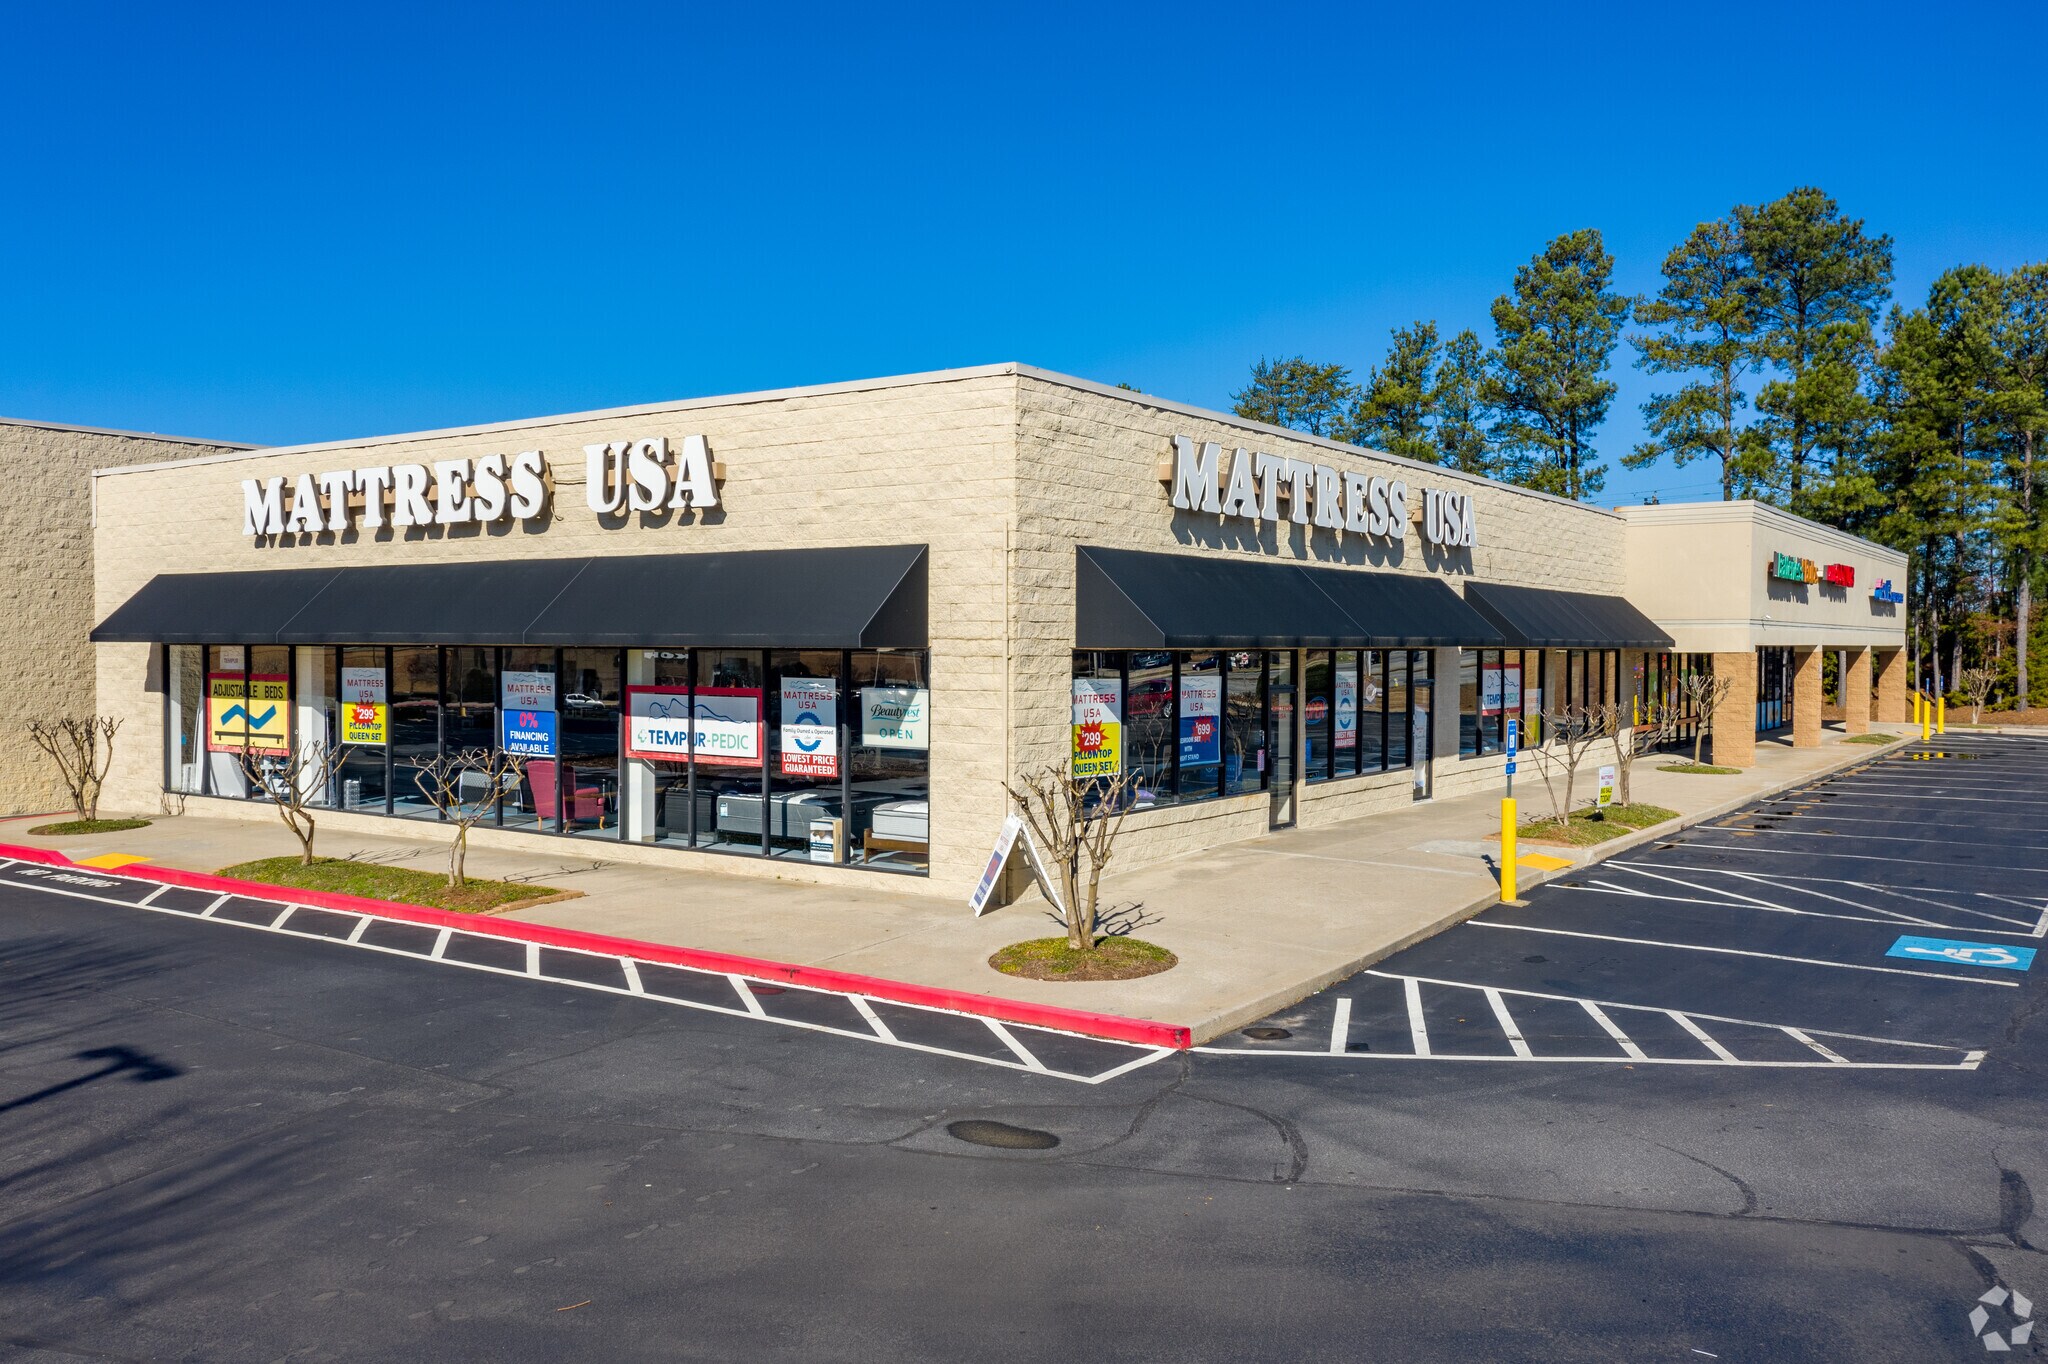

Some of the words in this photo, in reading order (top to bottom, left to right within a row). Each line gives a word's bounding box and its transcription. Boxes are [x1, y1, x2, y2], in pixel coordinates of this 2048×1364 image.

[242, 450, 548, 536] MATTRESS
[583, 434, 718, 514] USA
[1169, 434, 1407, 539] MATTRESS
[1421, 488, 1477, 548] USA
[346, 679, 385, 688] MATTRESS
[507, 684, 552, 694] MATTRESS
[213, 684, 258, 698] ADJUSTALE
[264, 685, 284, 699] BEDS
[358, 690, 374, 698] USA
[783, 691, 833, 701] MATTRESS
[1182, 689, 1217, 699] MATTRESS
[520, 696, 538, 706] USA
[1072, 693, 1116, 705] MATTRESS
[1486, 692, 1519, 705] TEMPR-PEDIC
[798, 701, 817, 709] USA
[871, 703, 920, 719] Beautyrest
[1190, 702, 1203, 711] USA
[1306, 702, 1324, 719] OPEN
[356, 706, 374, 720] $299
[1083, 708, 1101, 718] USA
[519, 711, 539, 729] 0%
[880, 728, 913, 739] OPEN
[1195, 722, 1210, 735] $699
[349, 731, 370, 740] QUEEN
[371, 733, 382, 741] SET
[509, 730, 549, 742] FINANCING
[1081, 731, 1101, 746] $299
[510, 742, 550, 754] AVAILABLE
[783, 753, 811, 763] LOWEST
[812, 755, 835, 765] PRICE
[784, 763, 836, 775] GUARANTEED!
[1074, 763, 1097, 775] QUEEN
[1099, 761, 1112, 771] SET
